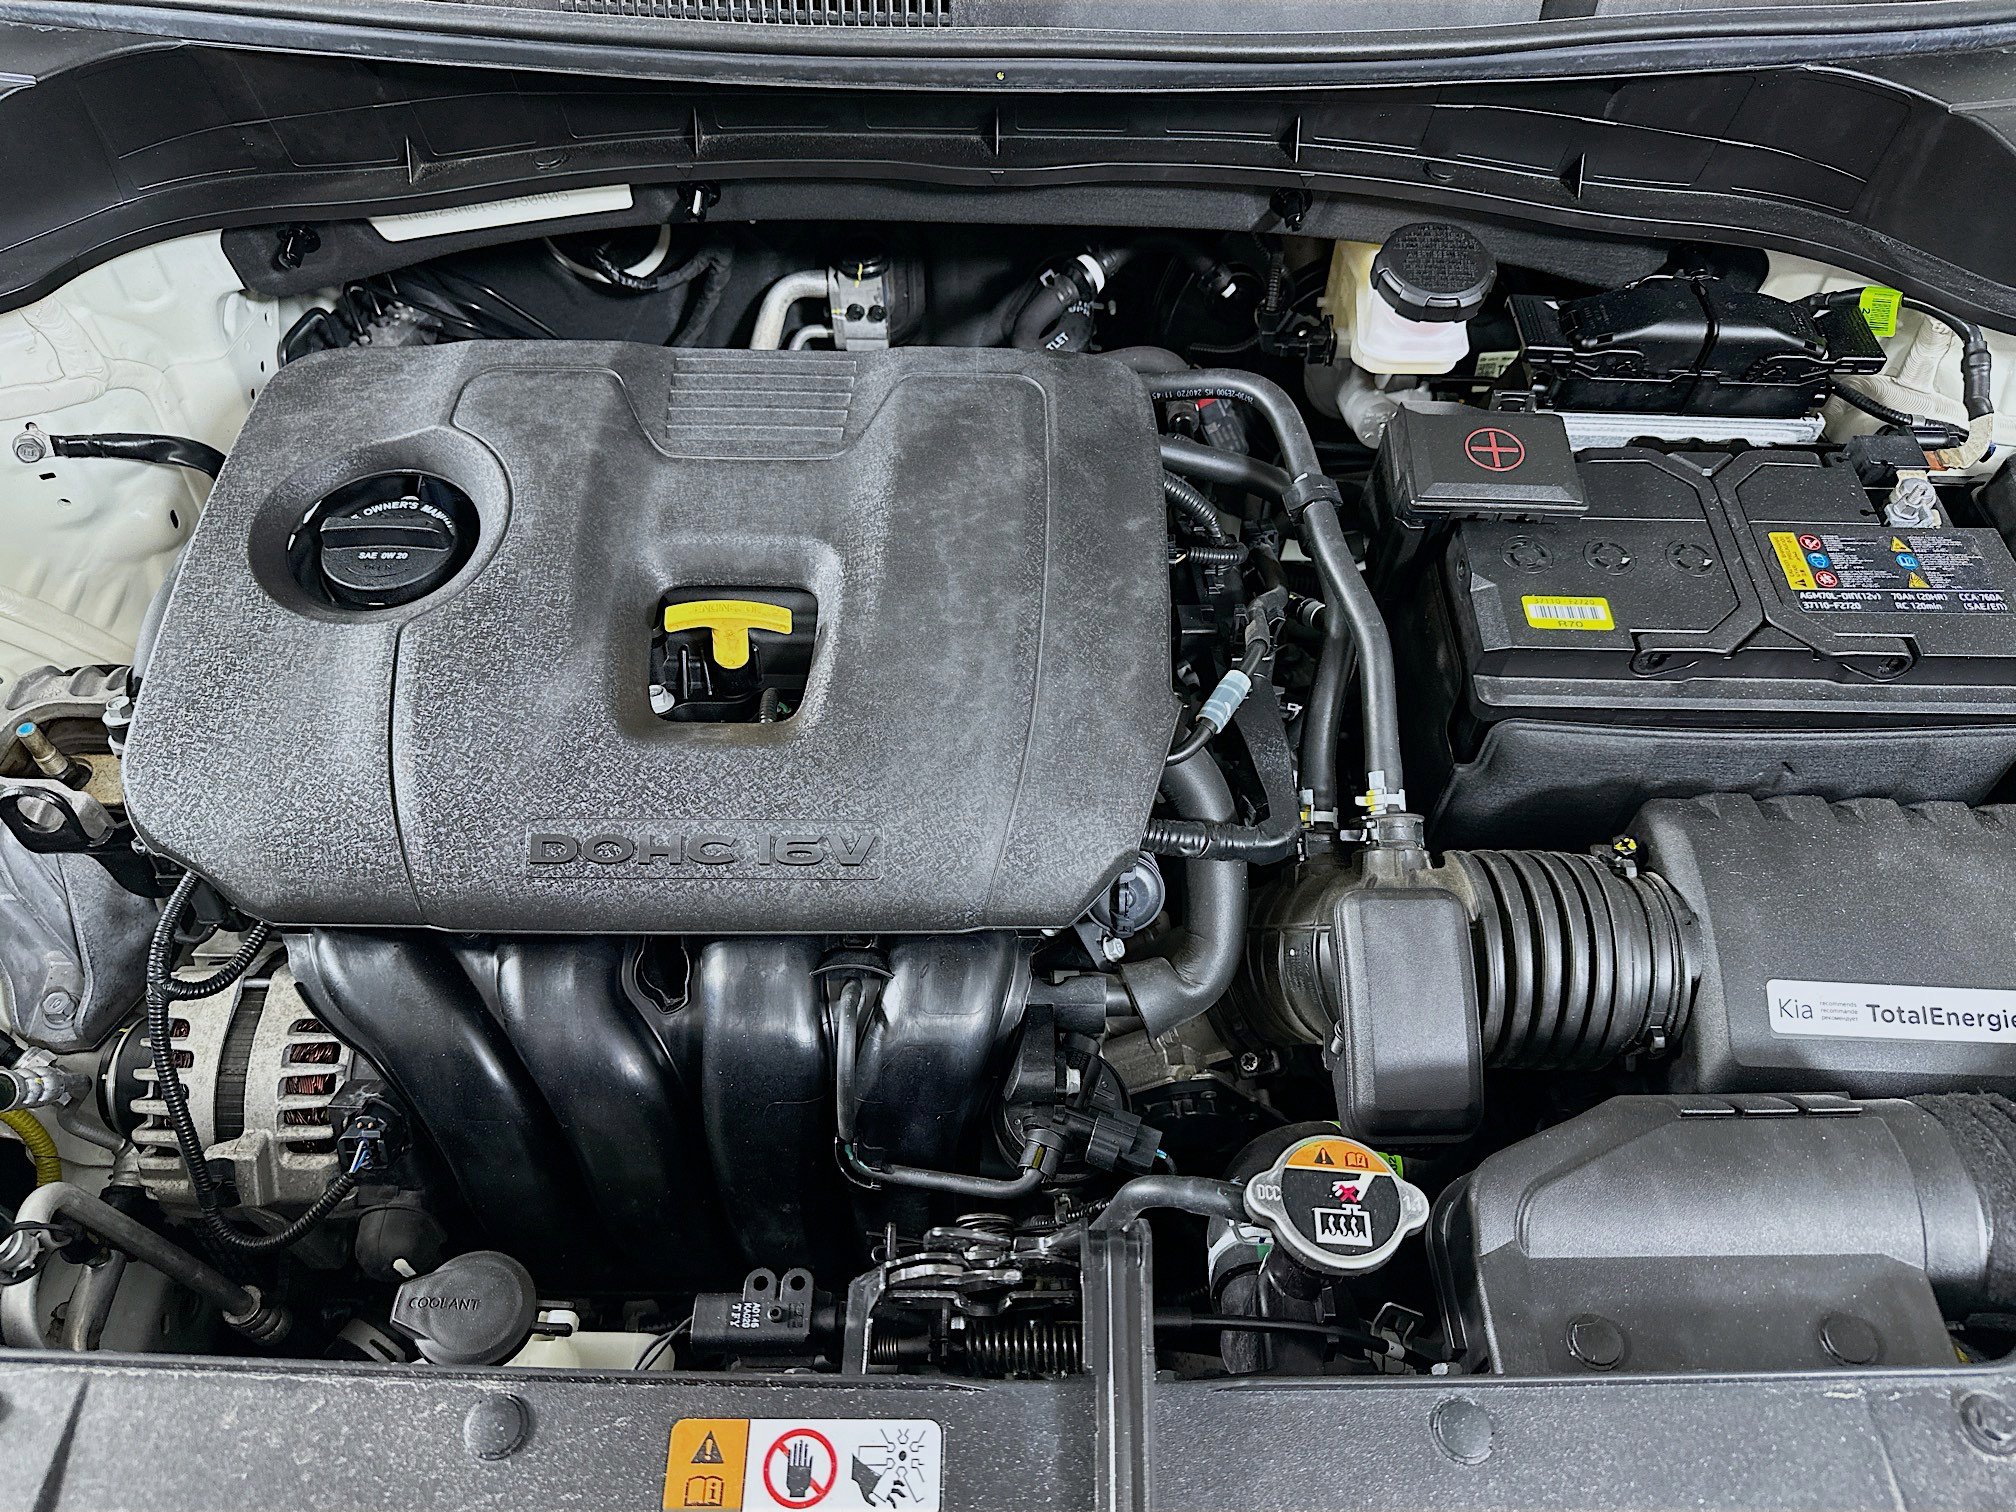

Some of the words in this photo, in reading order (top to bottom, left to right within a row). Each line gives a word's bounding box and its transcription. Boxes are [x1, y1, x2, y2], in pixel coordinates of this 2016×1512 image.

[363, 501, 419, 516] OWNER'S
[358, 552, 378, 560] SAE
[1890, 592, 1916, 601] 70Ah
[1916, 592, 1948, 601] (20HR)
[1802, 601, 1862, 610] 37110-F2720
[1894, 602, 1909, 610] RC
[1910, 602, 1943, 611] 120min
[1557, 620, 1584, 629] R70
[529, 832, 738, 867] DOHC
[757, 833, 878, 867] 16V
[1778, 998, 1813, 1020] Kia
[1256, 1184, 1282, 1201] DCC
[408, 1296, 482, 1312] COOLANT
